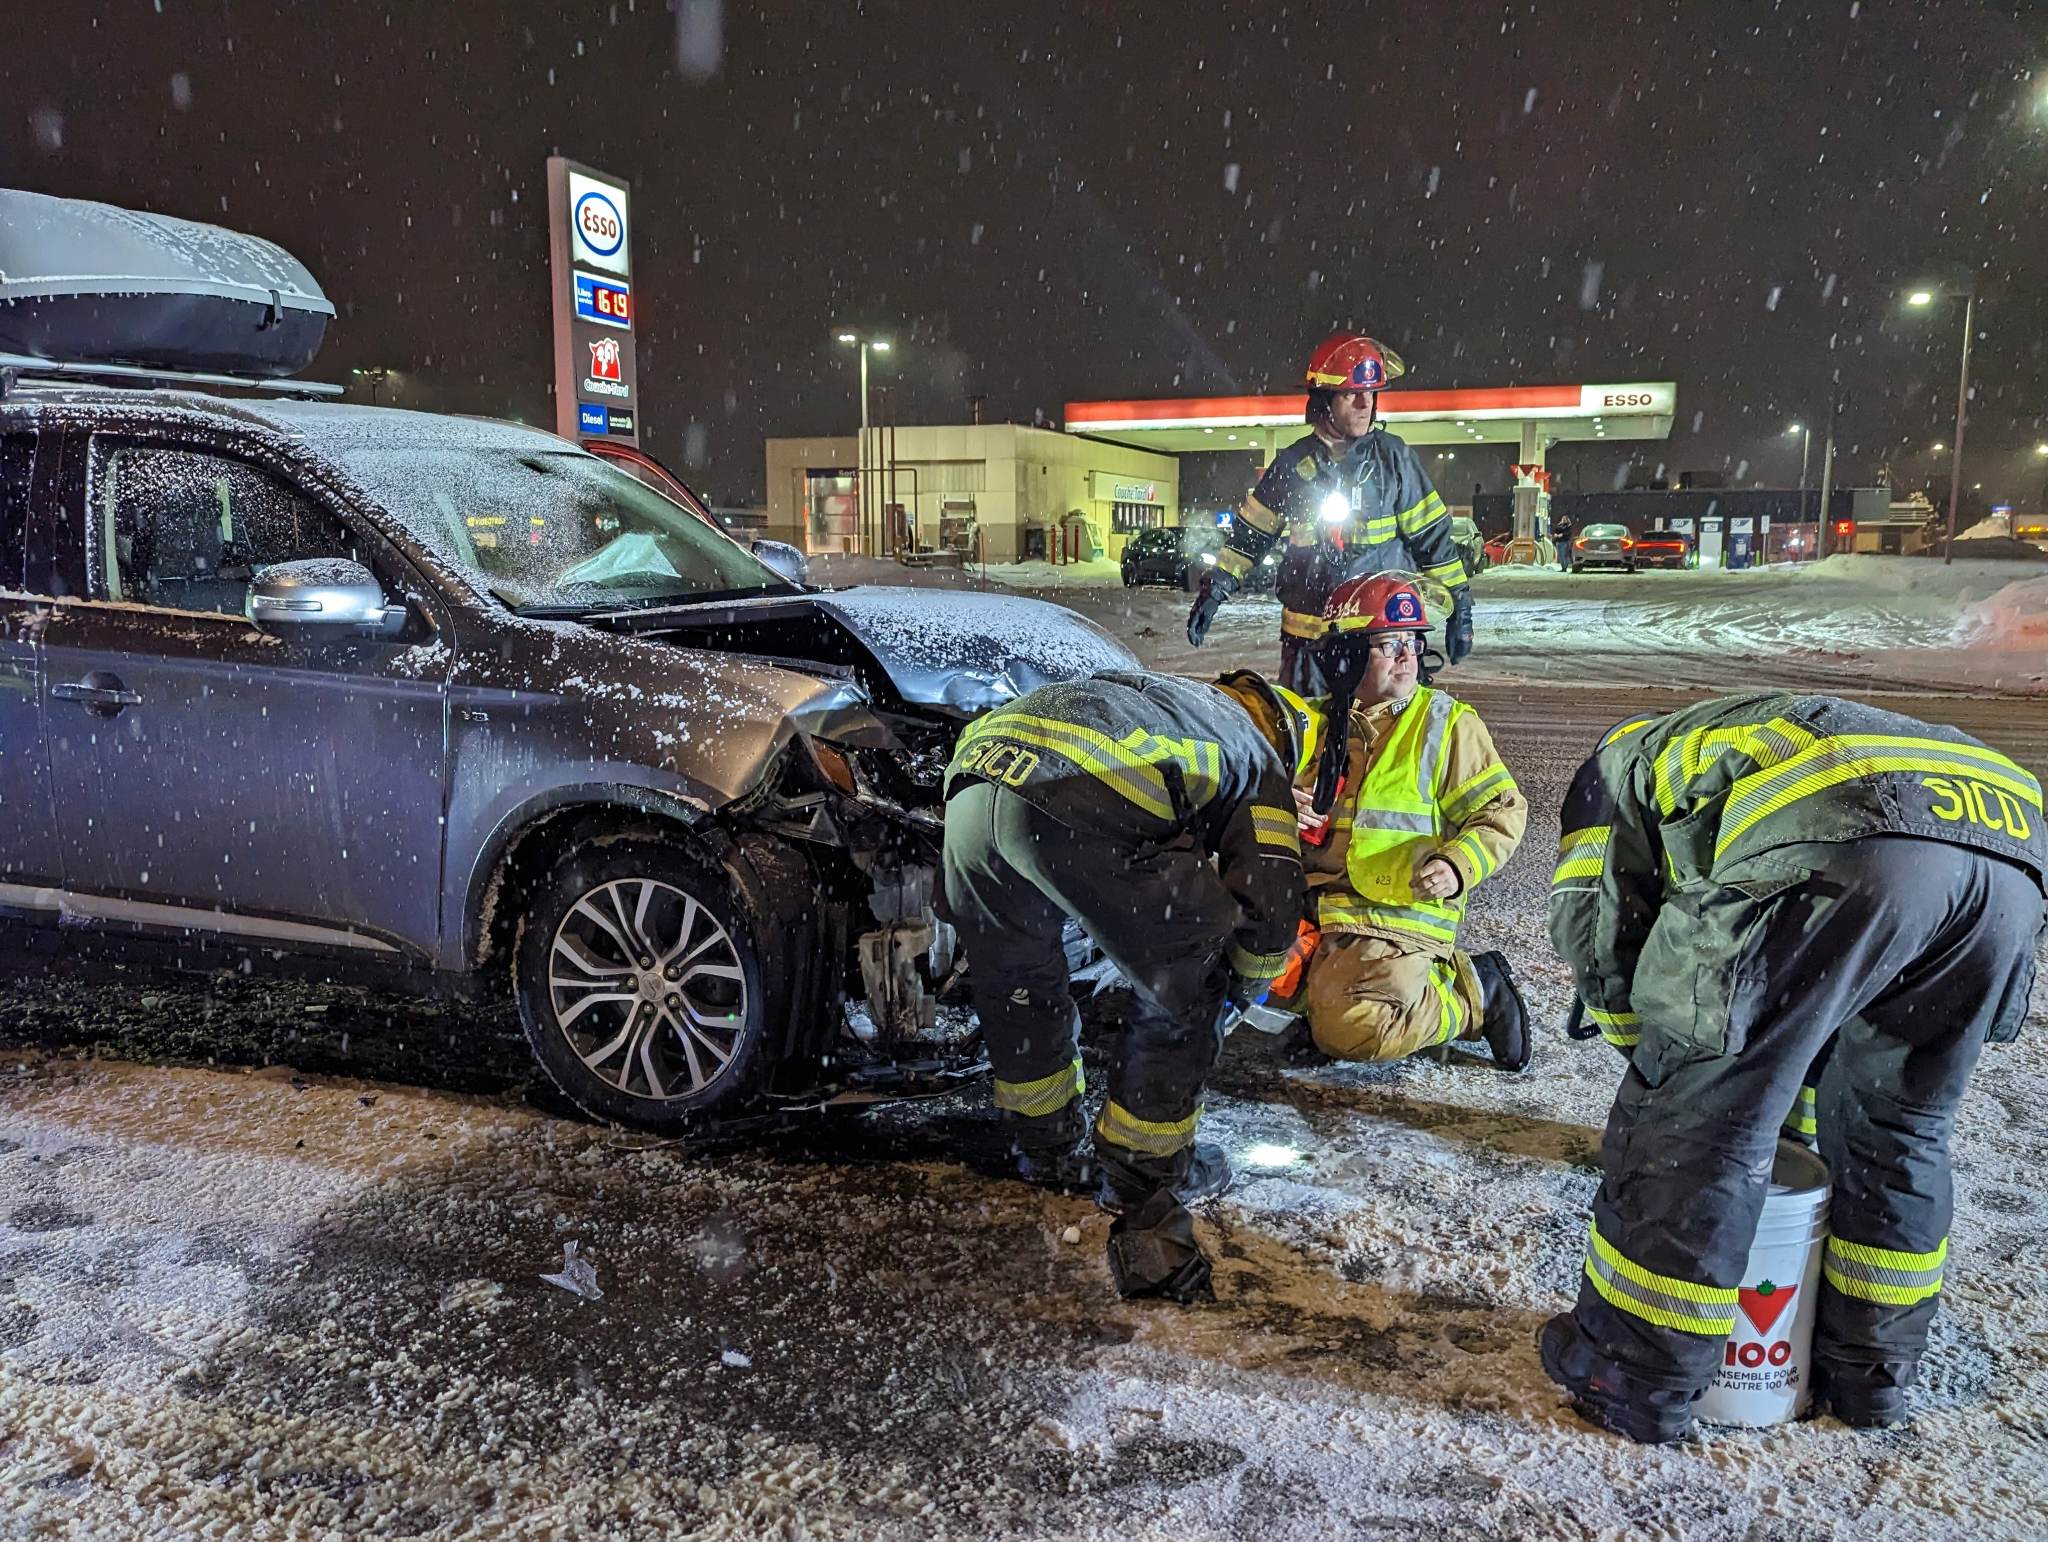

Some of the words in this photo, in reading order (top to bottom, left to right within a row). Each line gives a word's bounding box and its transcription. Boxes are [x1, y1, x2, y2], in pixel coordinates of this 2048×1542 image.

[1604, 394, 1652, 407] ESSO
[582, 412, 604, 426] Diesel
[961, 741, 1040, 787] SICD
[1921, 777, 2031, 841] SICD
[1725, 1341, 1791, 1368] 100
[1717, 1369, 1771, 1381] NSEMBLE
[1773, 1366, 1798, 1379] POUR
[1712, 1379, 1720, 1387] N
[1724, 1381, 1762, 1390] AUTRE
[1765, 1380, 1781, 1390] 100
[1785, 1375, 1799, 1386] ANS
